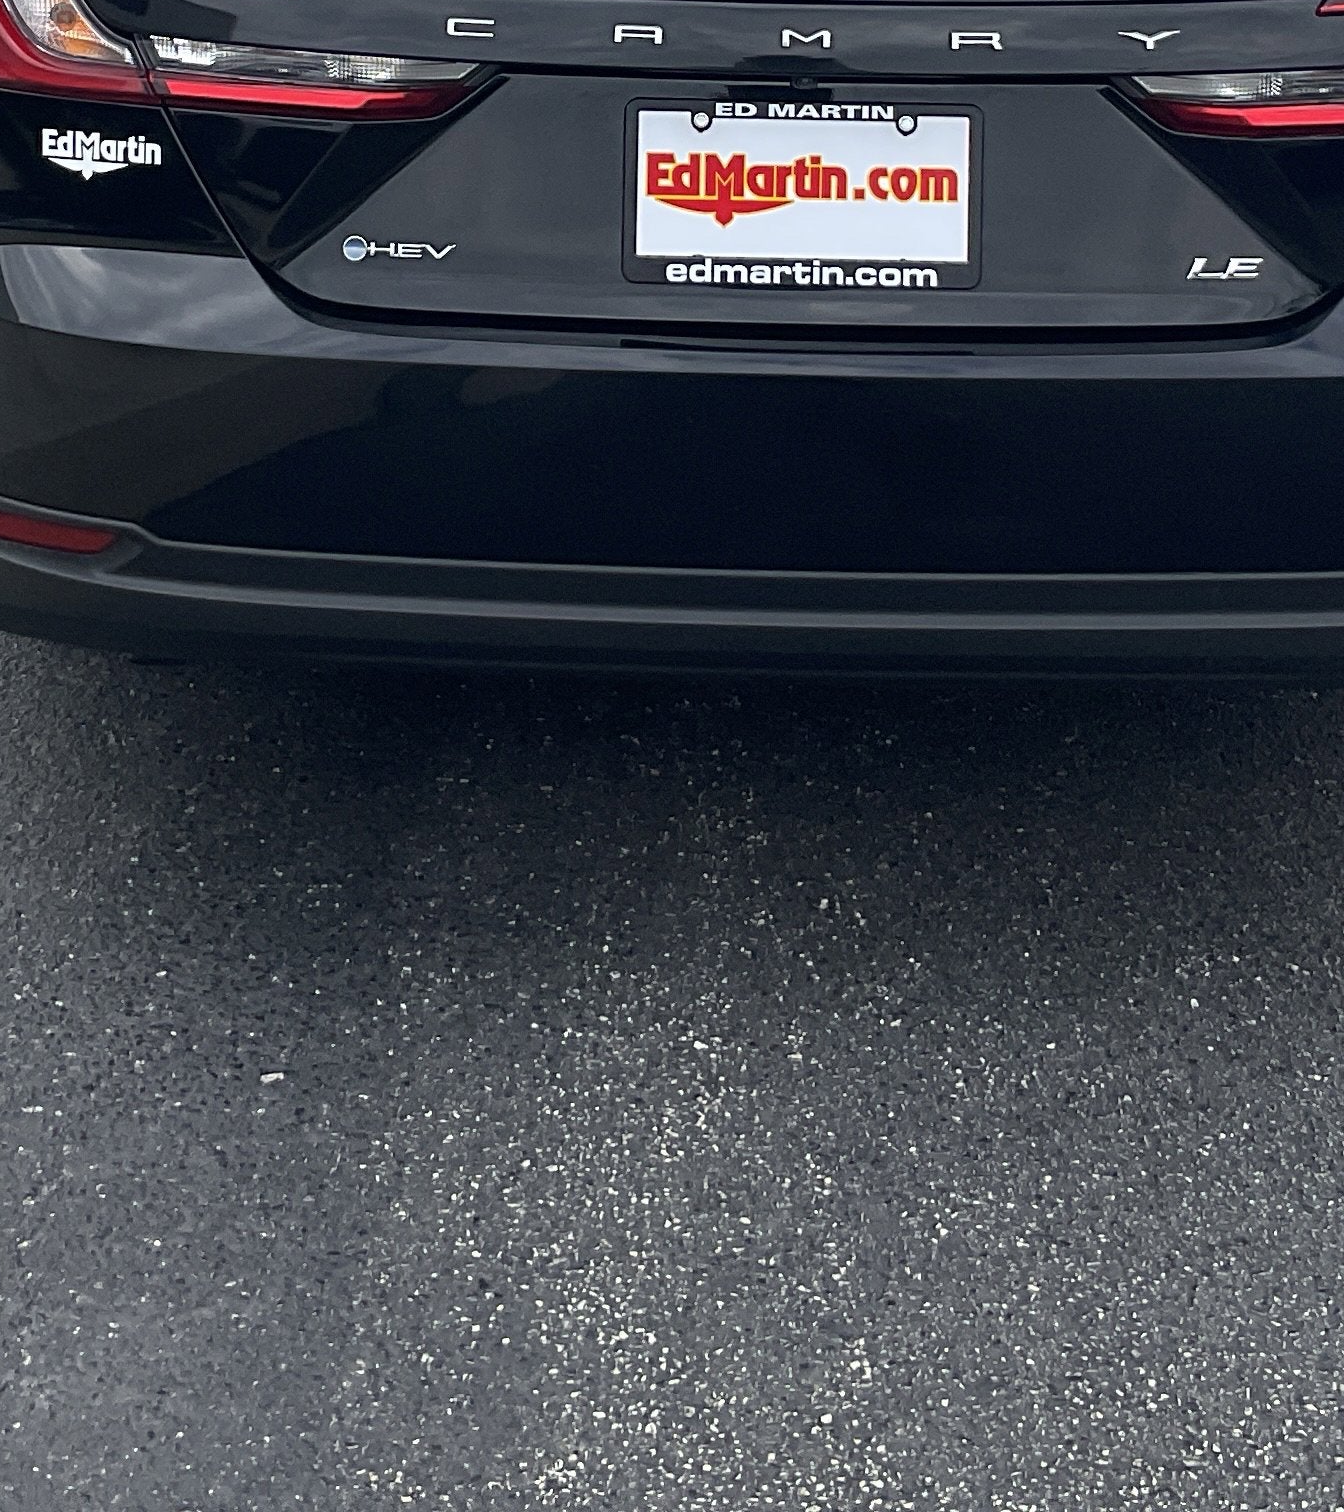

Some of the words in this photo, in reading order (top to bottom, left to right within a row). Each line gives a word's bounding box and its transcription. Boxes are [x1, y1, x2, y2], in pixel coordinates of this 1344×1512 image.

[445, 17, 1182, 51] CAMRY
[714, 103, 757, 118] ED
[767, 103, 895, 120] MARTIN
[42, 128, 162, 166] EdMartin
[646, 152, 959, 204] EdMartin.com
[369, 241, 456, 259] HEV
[665, 258, 938, 287] edmartin.com
[1186, 257, 1264, 279] LE
